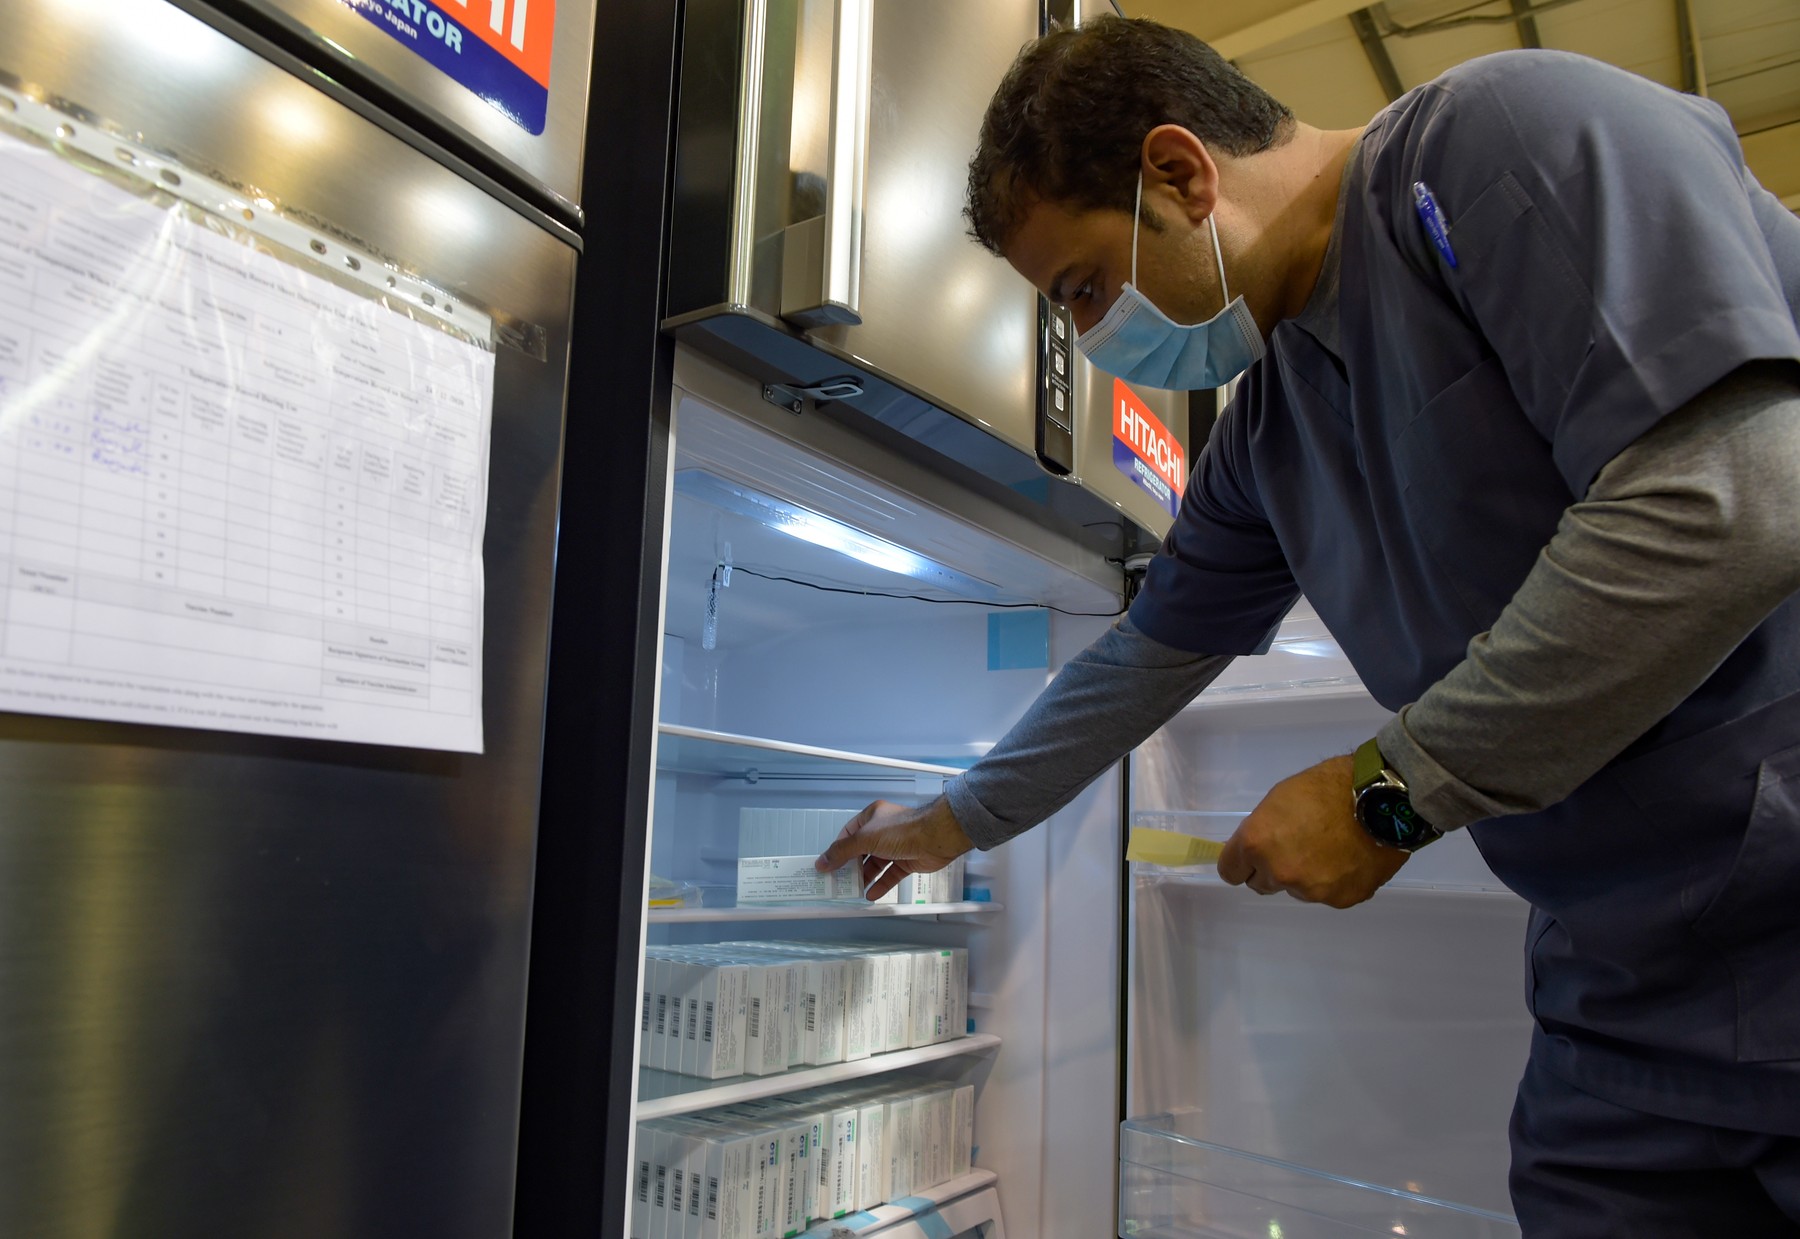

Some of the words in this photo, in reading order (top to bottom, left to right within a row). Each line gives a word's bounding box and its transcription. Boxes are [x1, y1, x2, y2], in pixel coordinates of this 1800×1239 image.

[384, 10, 418, 40] Japan
[384, 0, 463, 55] ATOR
[1121, 399, 1180, 488] HITACHI
[1134, 457, 1170, 501] REFRIGERATOR
